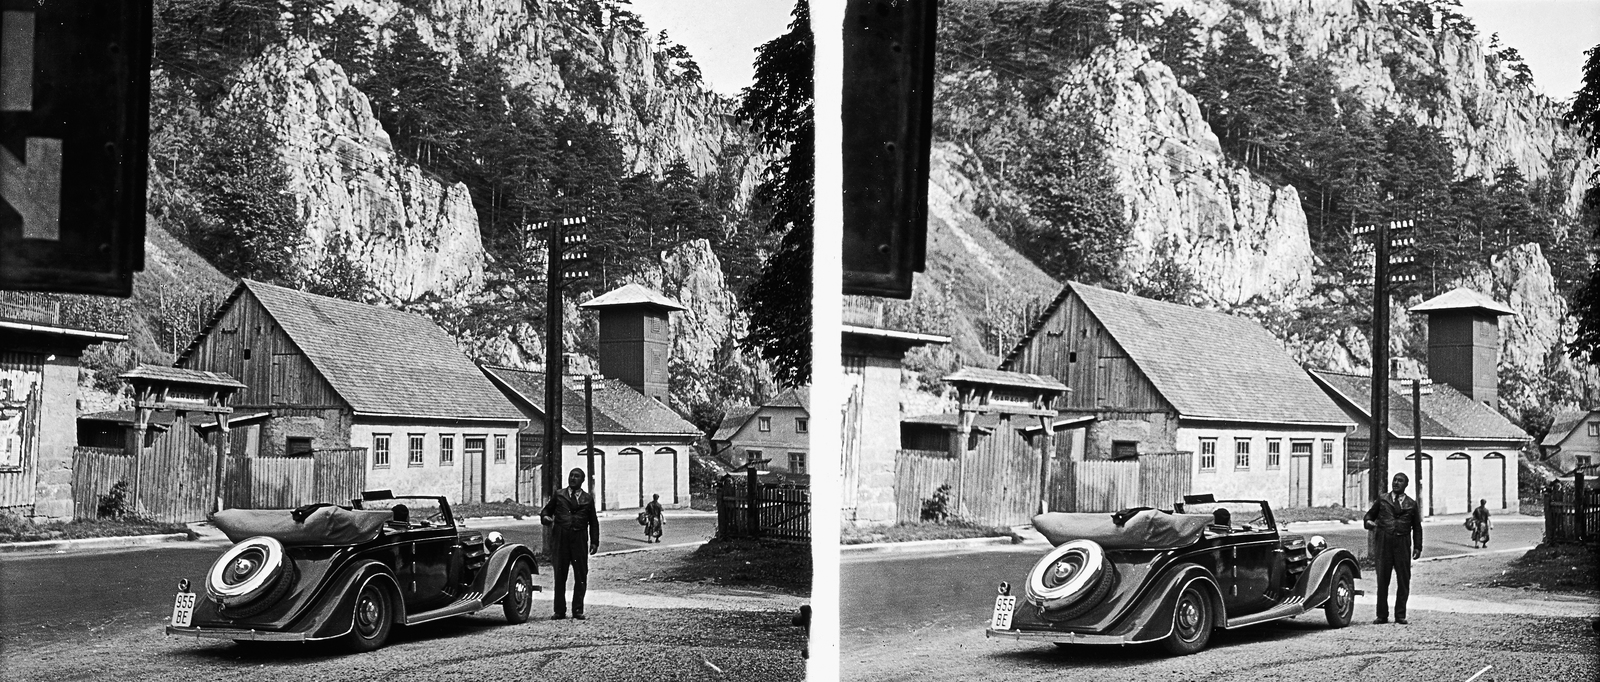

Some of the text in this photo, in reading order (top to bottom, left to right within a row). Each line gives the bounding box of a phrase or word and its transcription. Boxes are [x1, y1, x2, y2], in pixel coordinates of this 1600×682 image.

[170, 392, 200, 400] GARAGE
[176, 595, 194, 609] 955
[996, 598, 1014, 612] 955
[176, 610, 188, 624] BE
[996, 613, 1008, 627] BE
